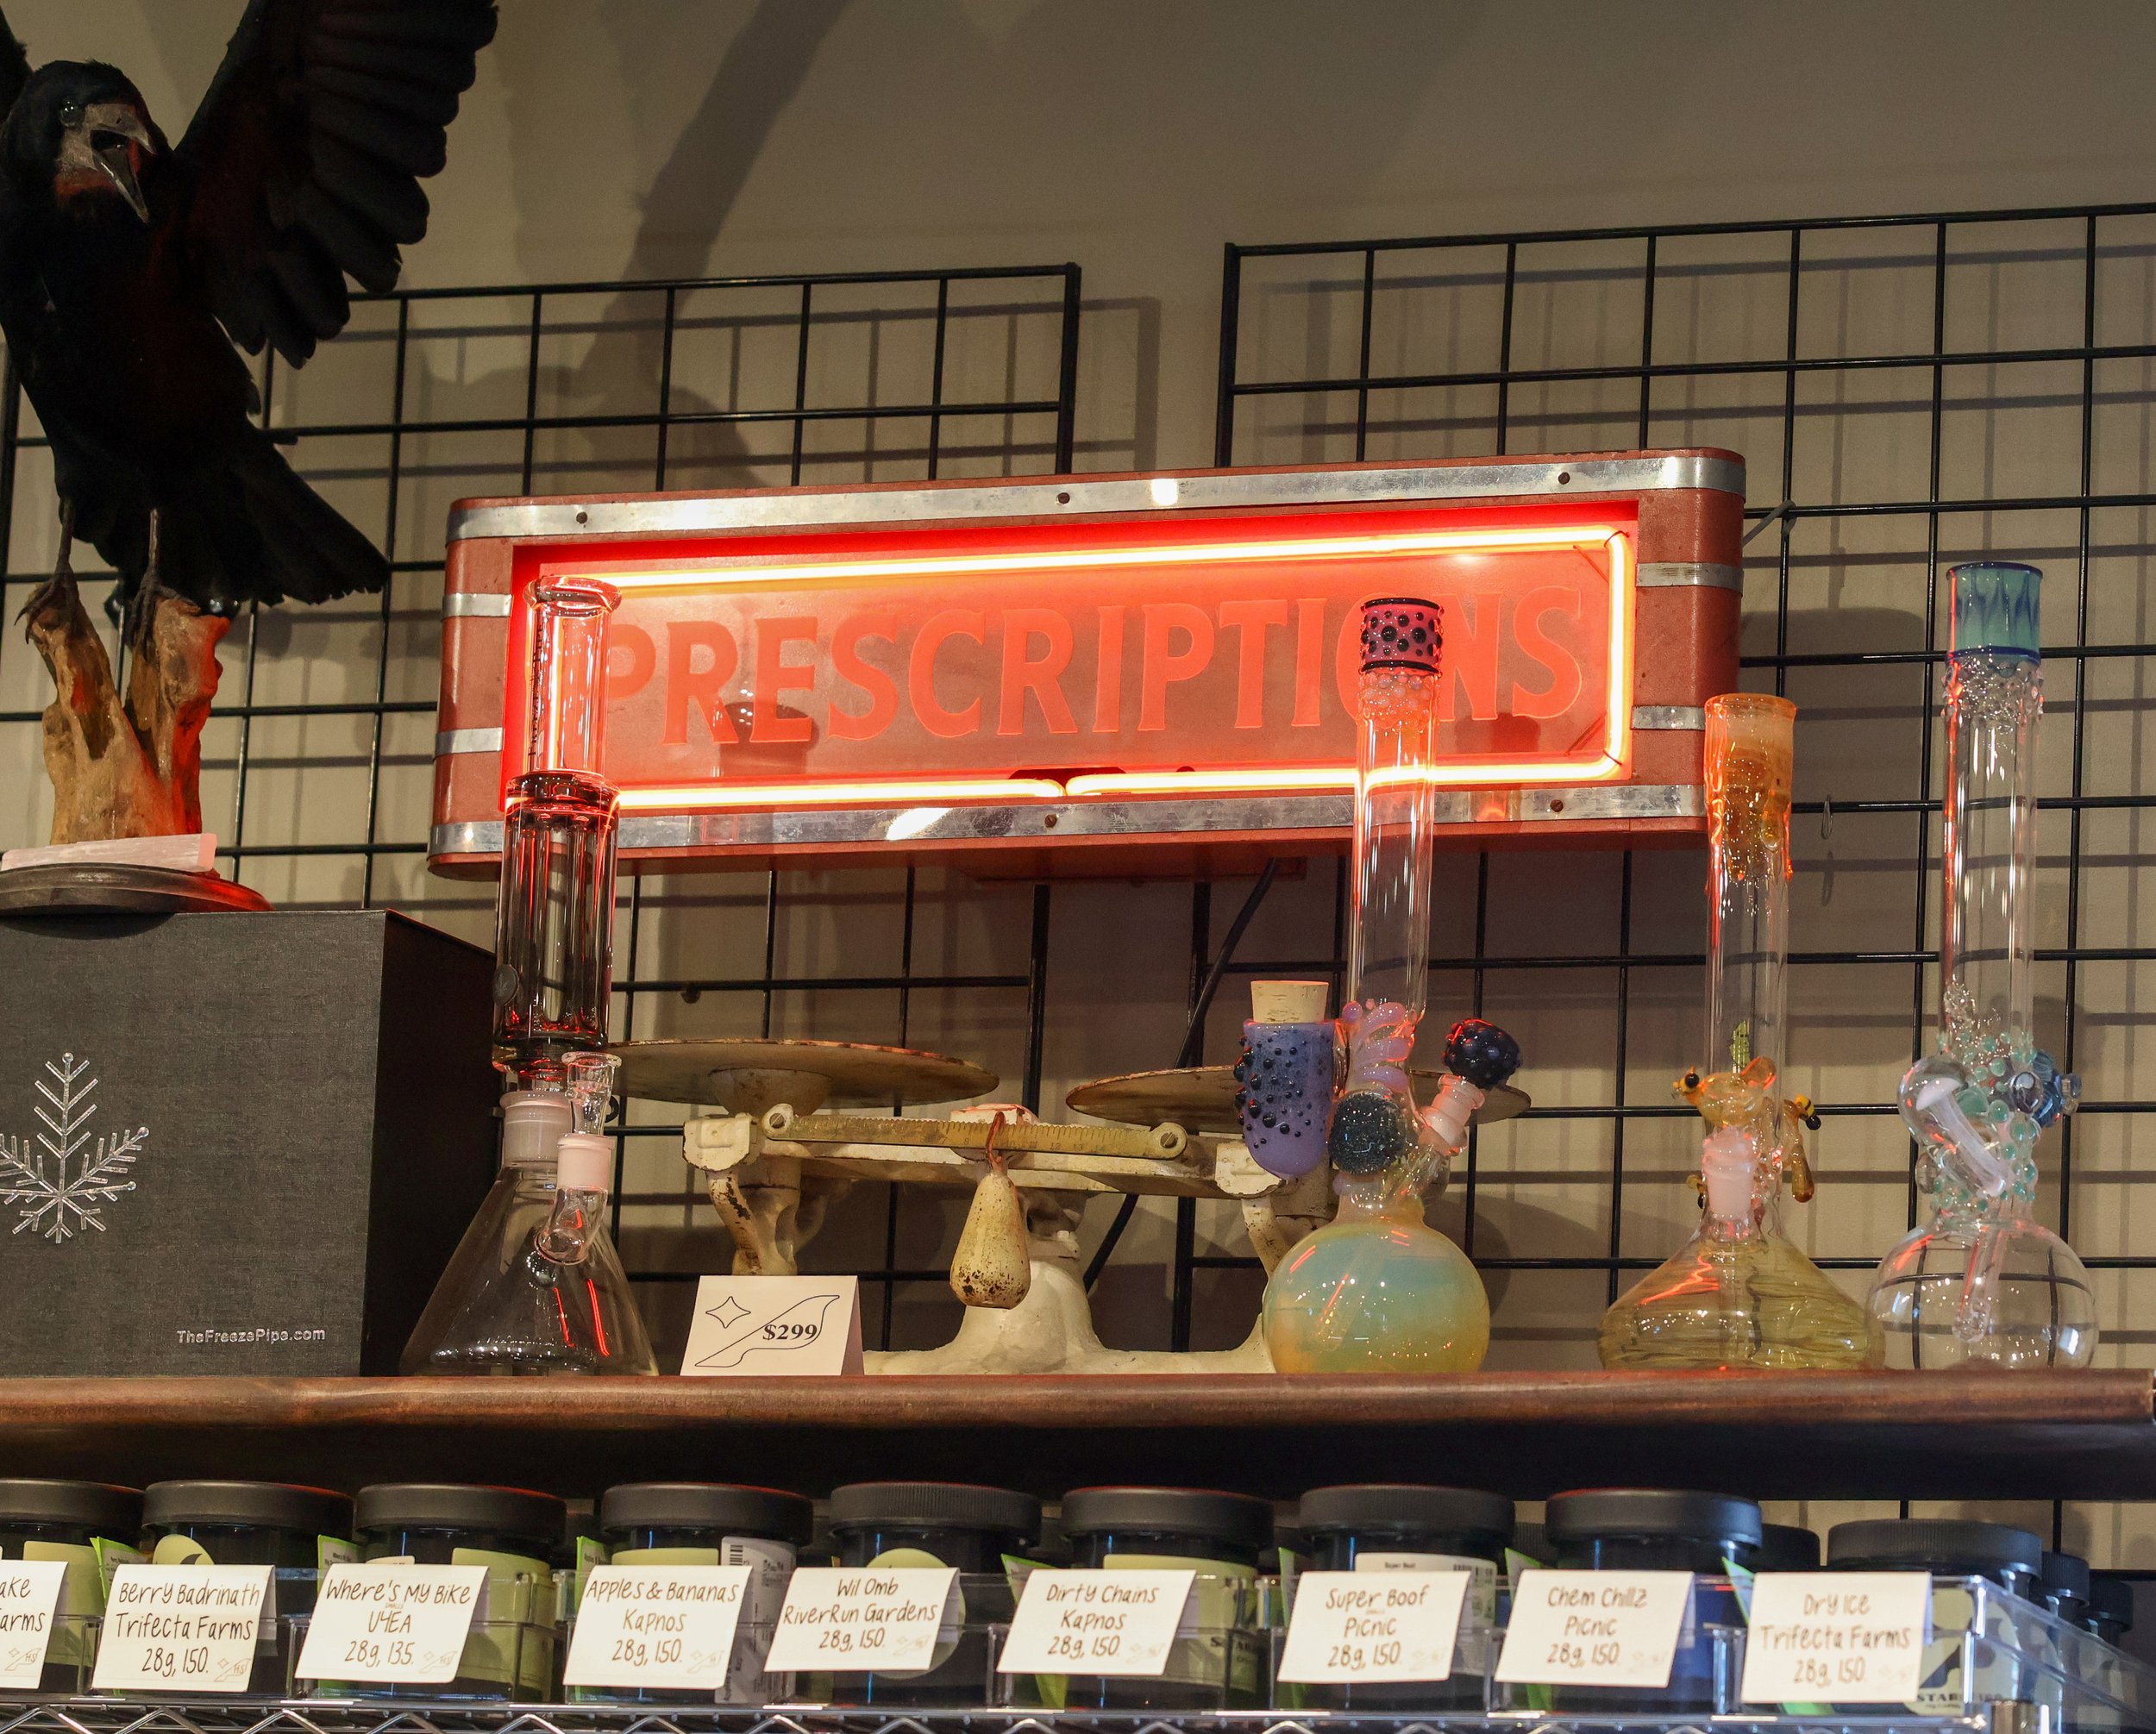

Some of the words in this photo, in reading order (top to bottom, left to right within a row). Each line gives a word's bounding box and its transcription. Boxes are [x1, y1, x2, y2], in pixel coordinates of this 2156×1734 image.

[177, 1328, 325, 1344] TheFreezePipe.com
[762, 1324, 818, 1341] $299
[119, 1580, 173, 1605] Berry
[177, 1578, 260, 1606] Badrinath
[326, 1579, 401, 1602] Where's
[433, 1584, 471, 1605] Bike
[586, 1578, 645, 1603] Apples
[646, 1581, 663, 1599] &
[666, 1582, 740, 1603] Bananas
[837, 1579, 861, 1597] Wil
[864, 1576, 899, 1595] Omb
[1046, 1582, 1098, 1603] Dirty
[1101, 1585, 1160, 1605] Chains
[1326, 1587, 1382, 1612] Super
[1387, 1584, 1431, 1607] Boof
[1547, 1586, 1595, 1607] Chem
[864, 1599, 938, 1623] Gardens
[1803, 1593, 1839, 1616] Dry
[0, 1607, 46, 1632] arms
[116, 1612, 191, 1639] Trifecta
[197, 1615, 254, 1641] Farms
[367, 1610, 412, 1634] U4EA
[622, 1609, 687, 1635] Kapnos
[1060, 1609, 1128, 1632] Kapnos
[1344, 1617, 1397, 1637] Picnic
[1564, 1614, 1618, 1636] Picnic
[818, 1631, 854, 1653] 28g,
[1047, 1636, 1085, 1660] 28g,
[1759, 1624, 1844, 1651] Trifecta
[1850, 1624, 1912, 1650] Farms
[141, 1648, 176, 1677] 28g,
[182, 1647, 209, 1674] 150.
[344, 1640, 380, 1667] 28g,
[387, 1641, 415, 1665] 135.
[611, 1639, 647, 1667] 28g,
